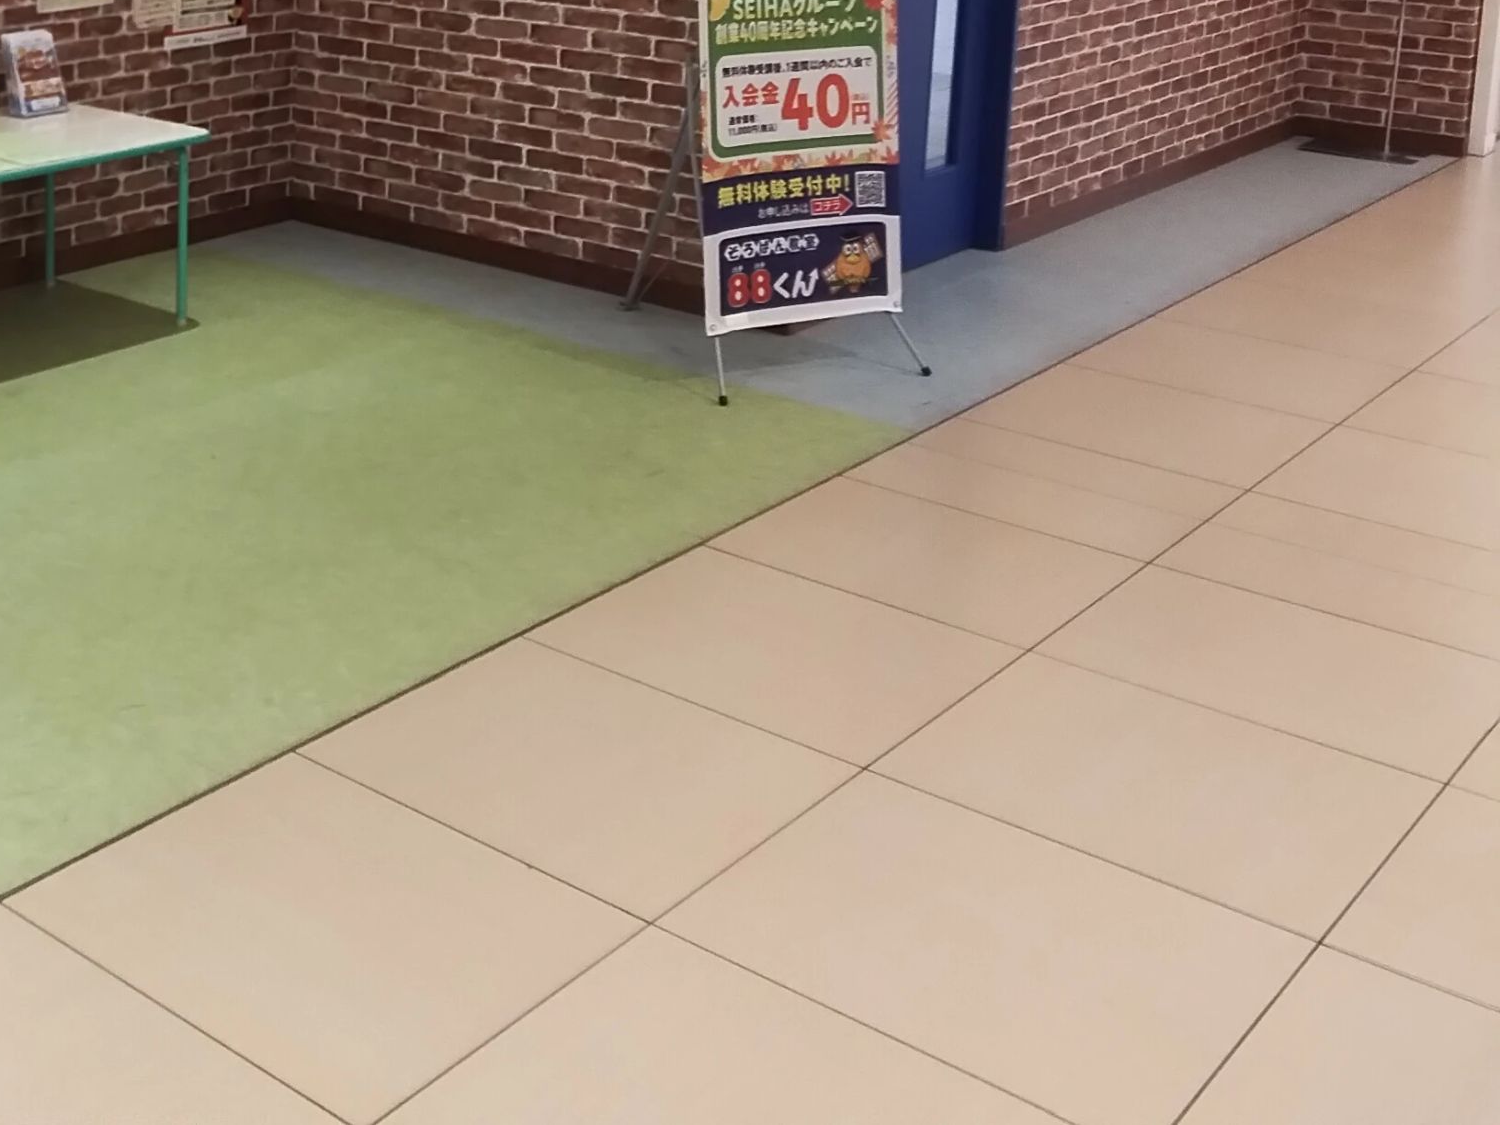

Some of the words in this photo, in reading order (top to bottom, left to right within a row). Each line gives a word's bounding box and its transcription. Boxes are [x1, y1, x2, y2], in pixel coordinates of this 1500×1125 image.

[722, 81, 780, 109] 入会金
[717, 174, 851, 209] 無料体験受付中！
[813, 200, 842, 213] コチラ
[727, 268, 820, 308] 88くん
